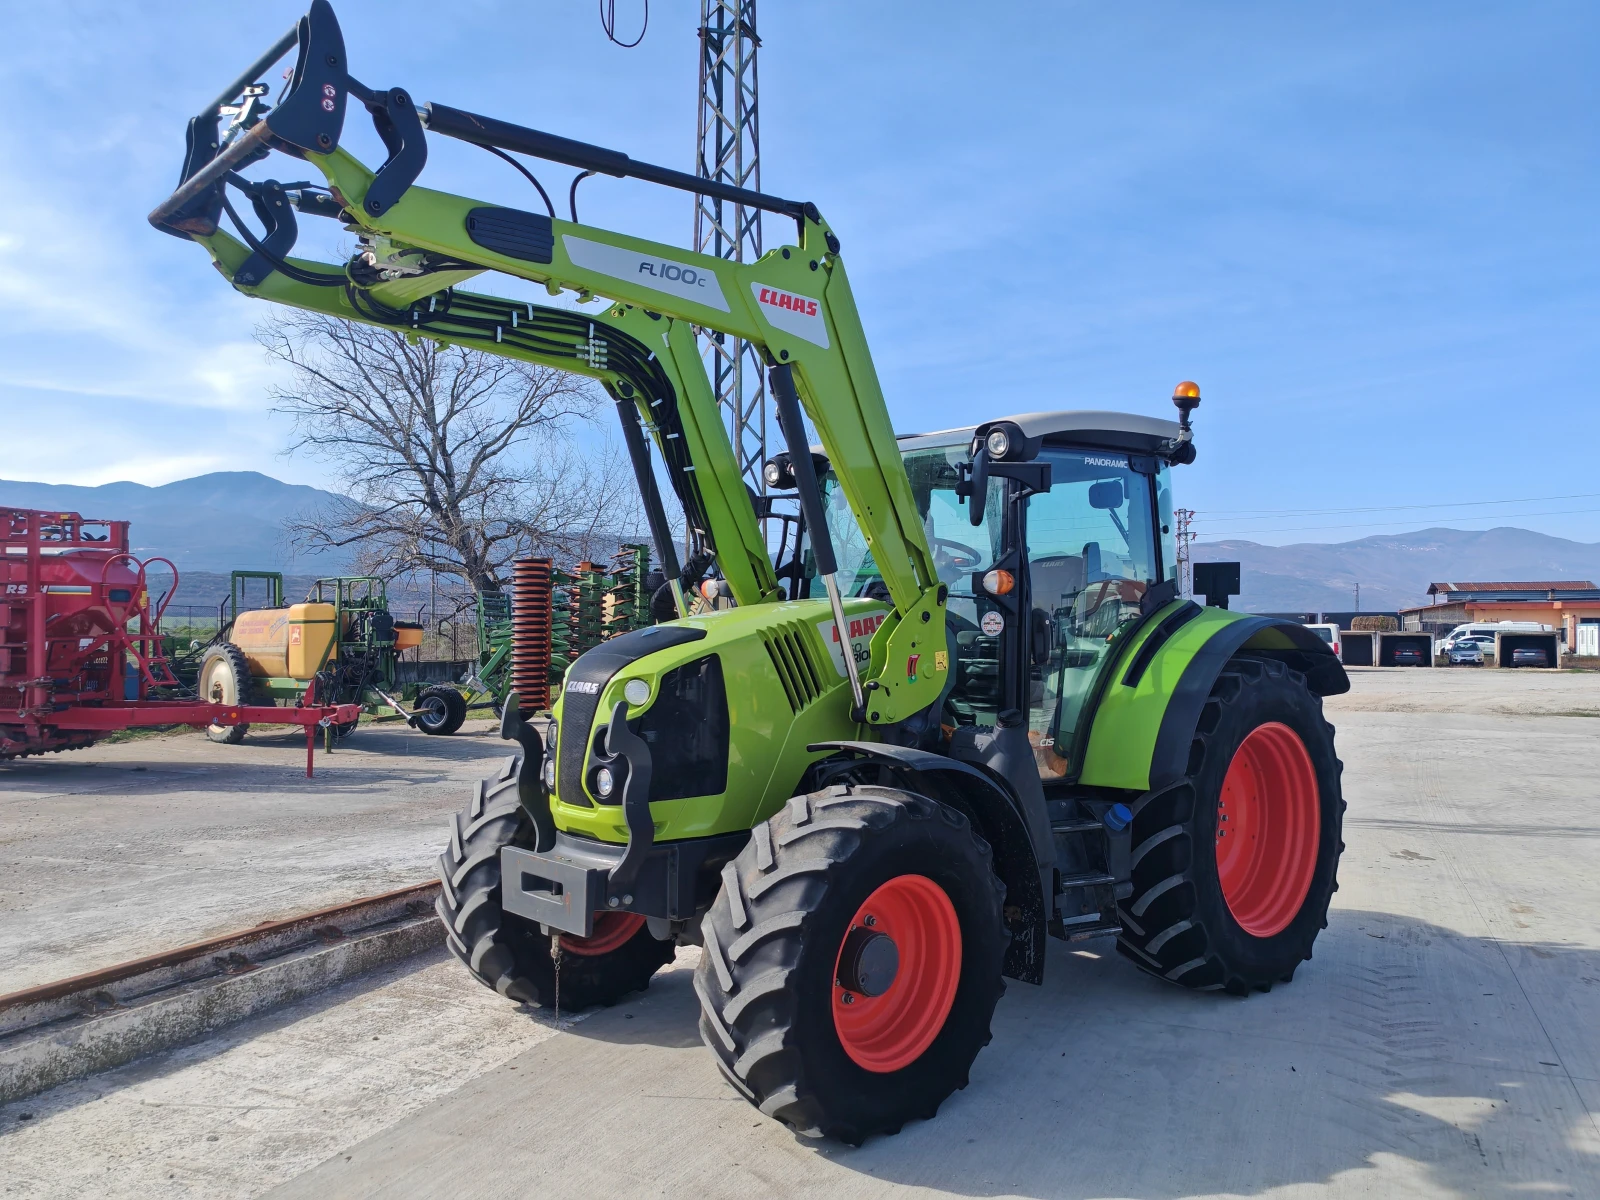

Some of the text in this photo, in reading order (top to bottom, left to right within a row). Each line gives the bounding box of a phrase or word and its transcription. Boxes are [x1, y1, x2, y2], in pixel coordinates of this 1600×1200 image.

[759, 287, 818, 317] CLAAS
[1084, 457, 1128, 469] PANORAMIC
[566, 680, 599, 695] CLAAS
[1040, 737, 1055, 747] CIS
